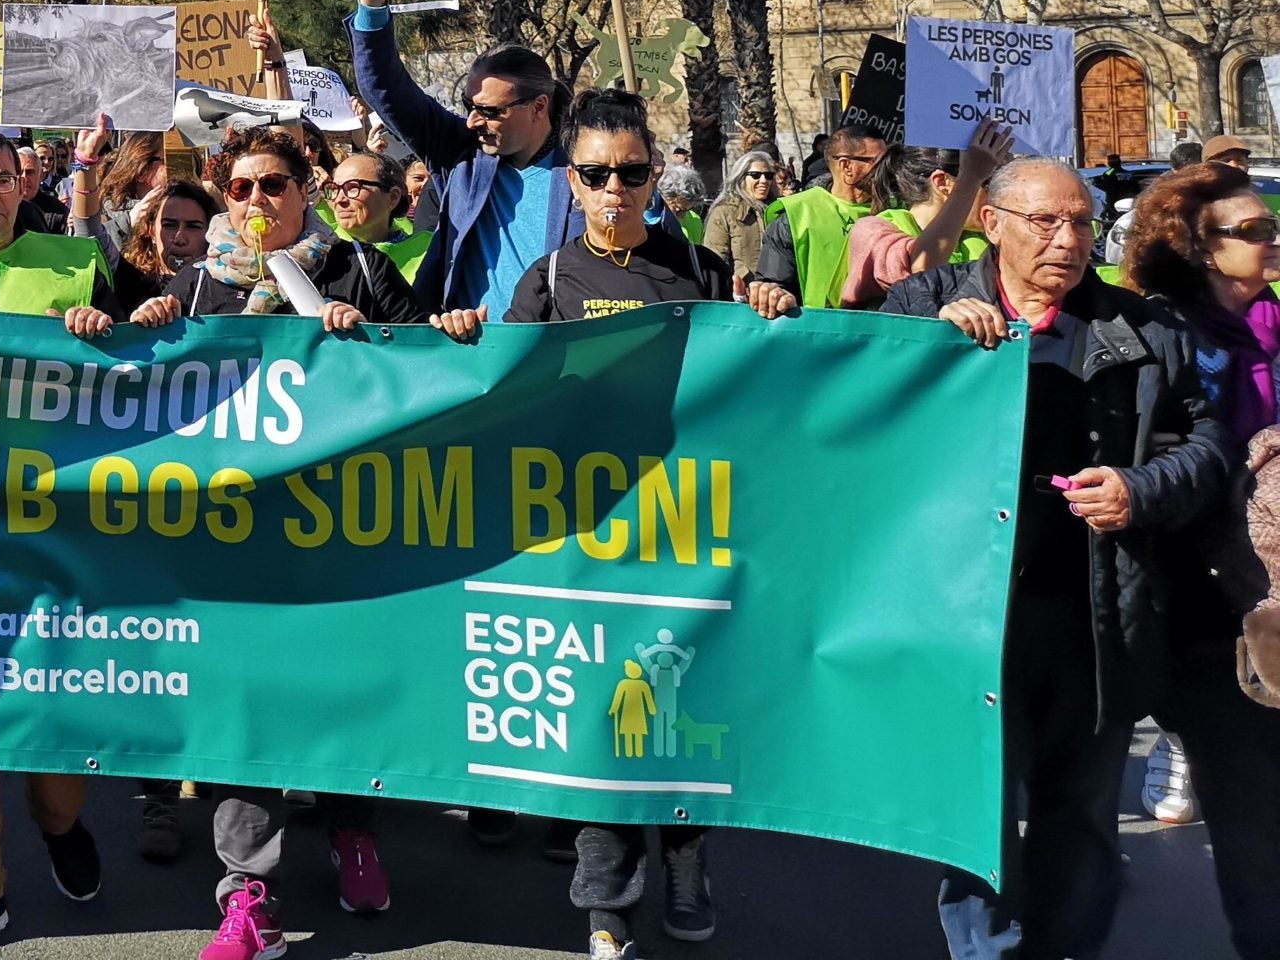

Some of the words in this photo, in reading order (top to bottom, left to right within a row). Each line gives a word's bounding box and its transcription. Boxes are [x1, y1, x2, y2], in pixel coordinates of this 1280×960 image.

[928, 24, 959, 43] LES
[962, 29, 1053, 51] PERSONES
[176, 43, 232, 70] NOT
[948, 46, 990, 62] AMB
[993, 48, 1032, 66] GOS
[311, 79, 332, 89] GOS
[312, 108, 332, 118] BCN
[950, 103, 991, 122] SOM
[995, 107, 1031, 126] BCN
[583, 299, 644, 310] PERSONES
[283, 446, 474, 549] SOM
[511, 446, 732, 567] BCN!
[465, 612, 605, 663] ESPAI
[464, 657, 576, 707] GOS
[467, 702, 568, 753] BCN
